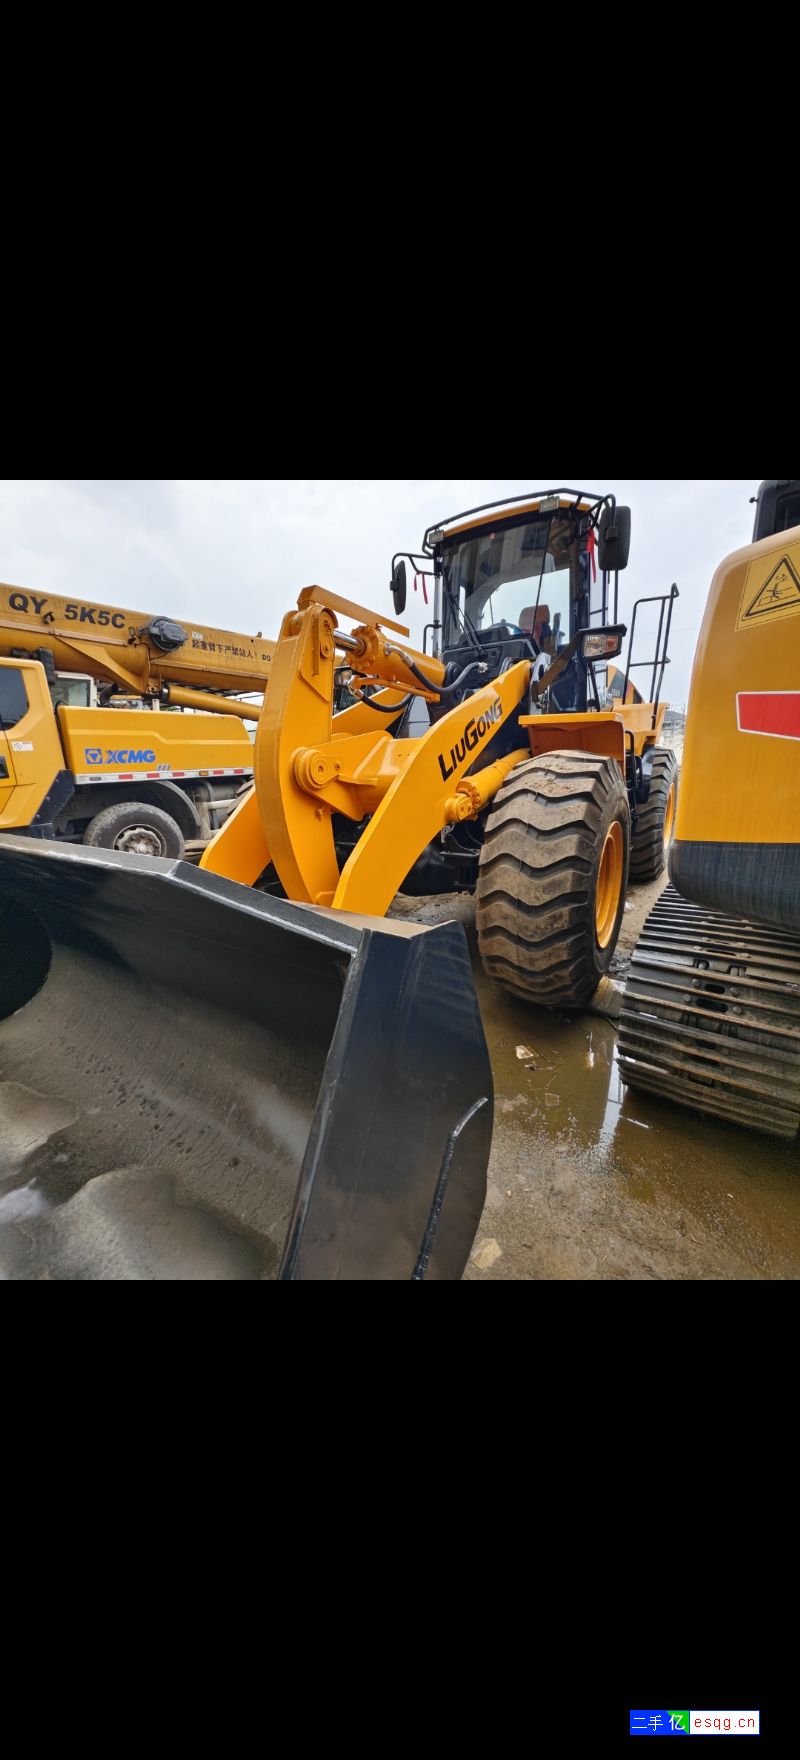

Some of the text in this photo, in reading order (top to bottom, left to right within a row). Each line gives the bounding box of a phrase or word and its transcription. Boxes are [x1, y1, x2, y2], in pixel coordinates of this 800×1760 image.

[8, 592, 126, 629] QY 5K5C
[106, 749, 156, 764] XCMG
